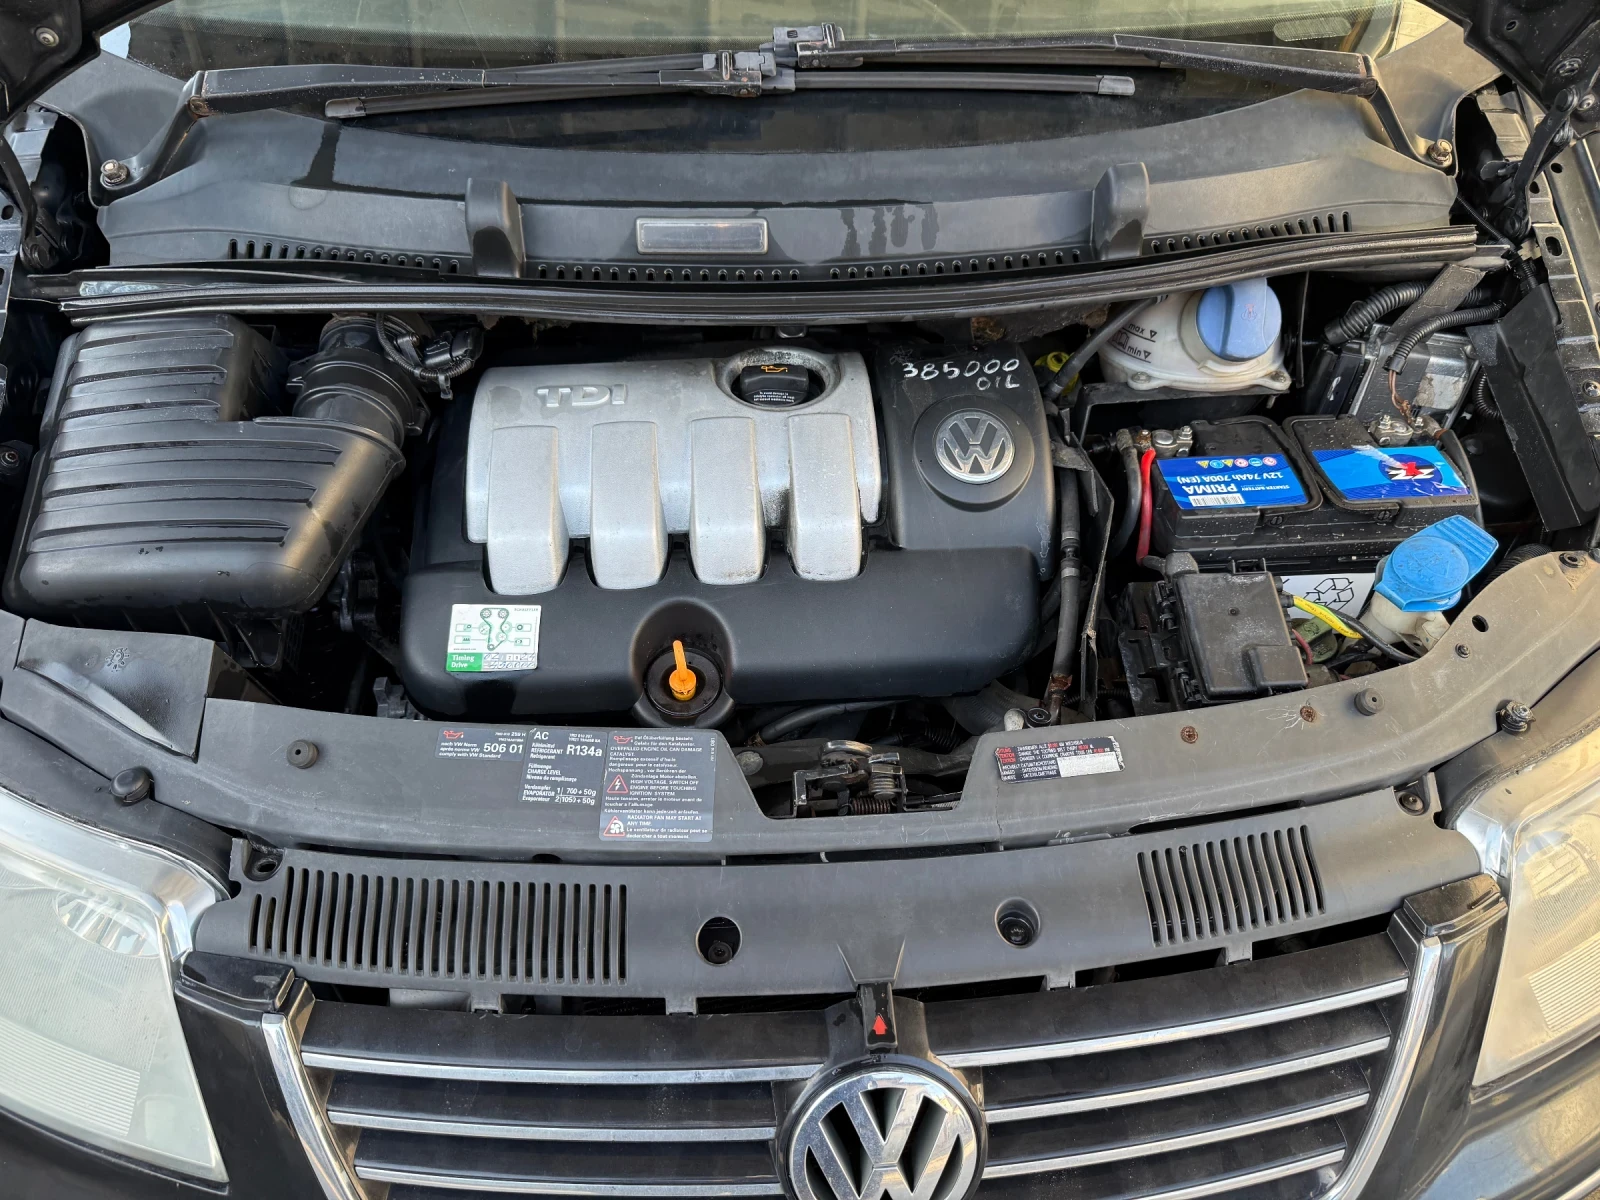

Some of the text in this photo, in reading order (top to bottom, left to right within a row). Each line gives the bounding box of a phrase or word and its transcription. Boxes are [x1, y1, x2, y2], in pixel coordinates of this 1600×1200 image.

[1128, 323, 1146, 335] max
[1126, 345, 1142, 357] min
[902, 358, 1020, 381] 385000
[536, 384, 626, 408] TDI
[1176, 471, 1284, 484] 12V 74Ah 700A (EN)
[1181, 483, 1238, 494] PRIMA
[452, 654, 475, 663] Timing
[533, 731, 550, 740] AC
[483, 742, 523, 754] 506 01
[566, 744, 603, 757] R134a
[583, 788, 597, 797] 50g
[582, 797, 595, 806] 50g
